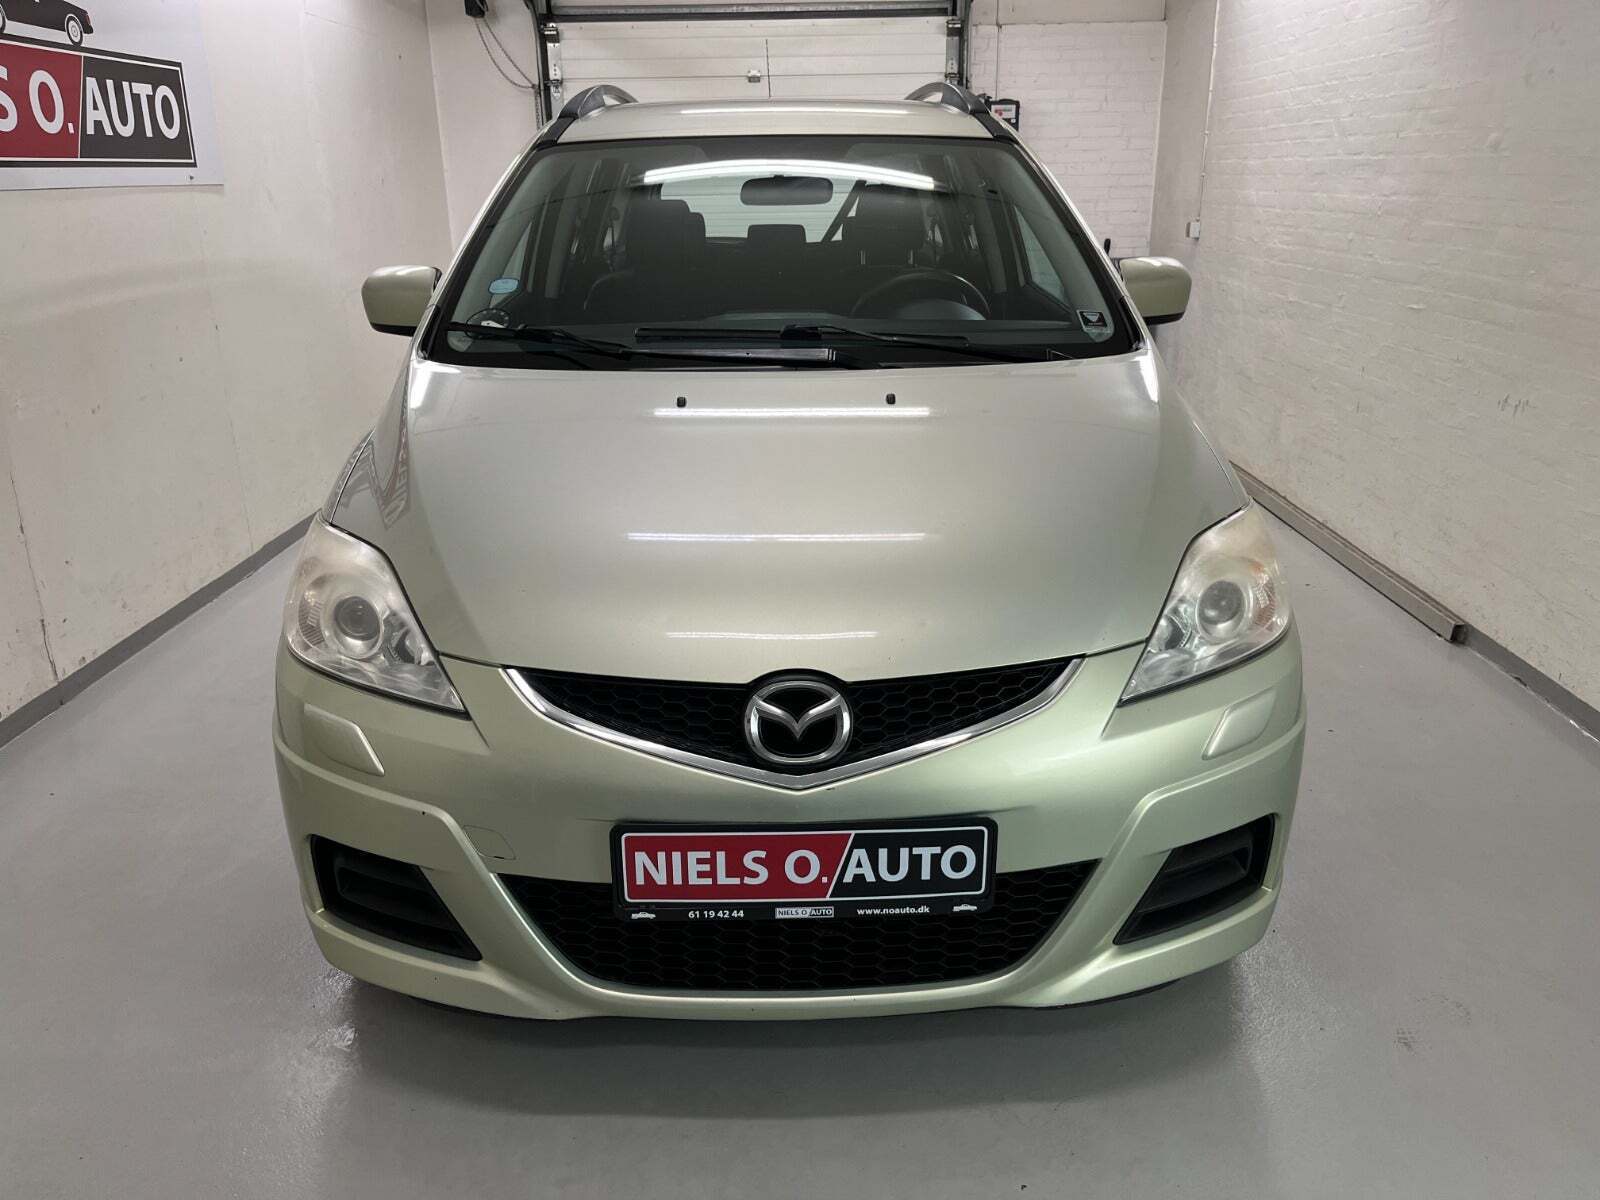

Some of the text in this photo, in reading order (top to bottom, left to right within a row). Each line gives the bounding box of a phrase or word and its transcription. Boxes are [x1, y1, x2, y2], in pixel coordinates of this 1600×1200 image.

[29, 70, 75, 134] O.
[86, 76, 180, 139] AUTO
[634, 844, 977, 885] NIELS O. AUTO
[688, 909, 744, 918] 61 19 42 44
[856, 905, 930, 915] www.noauto.dk
